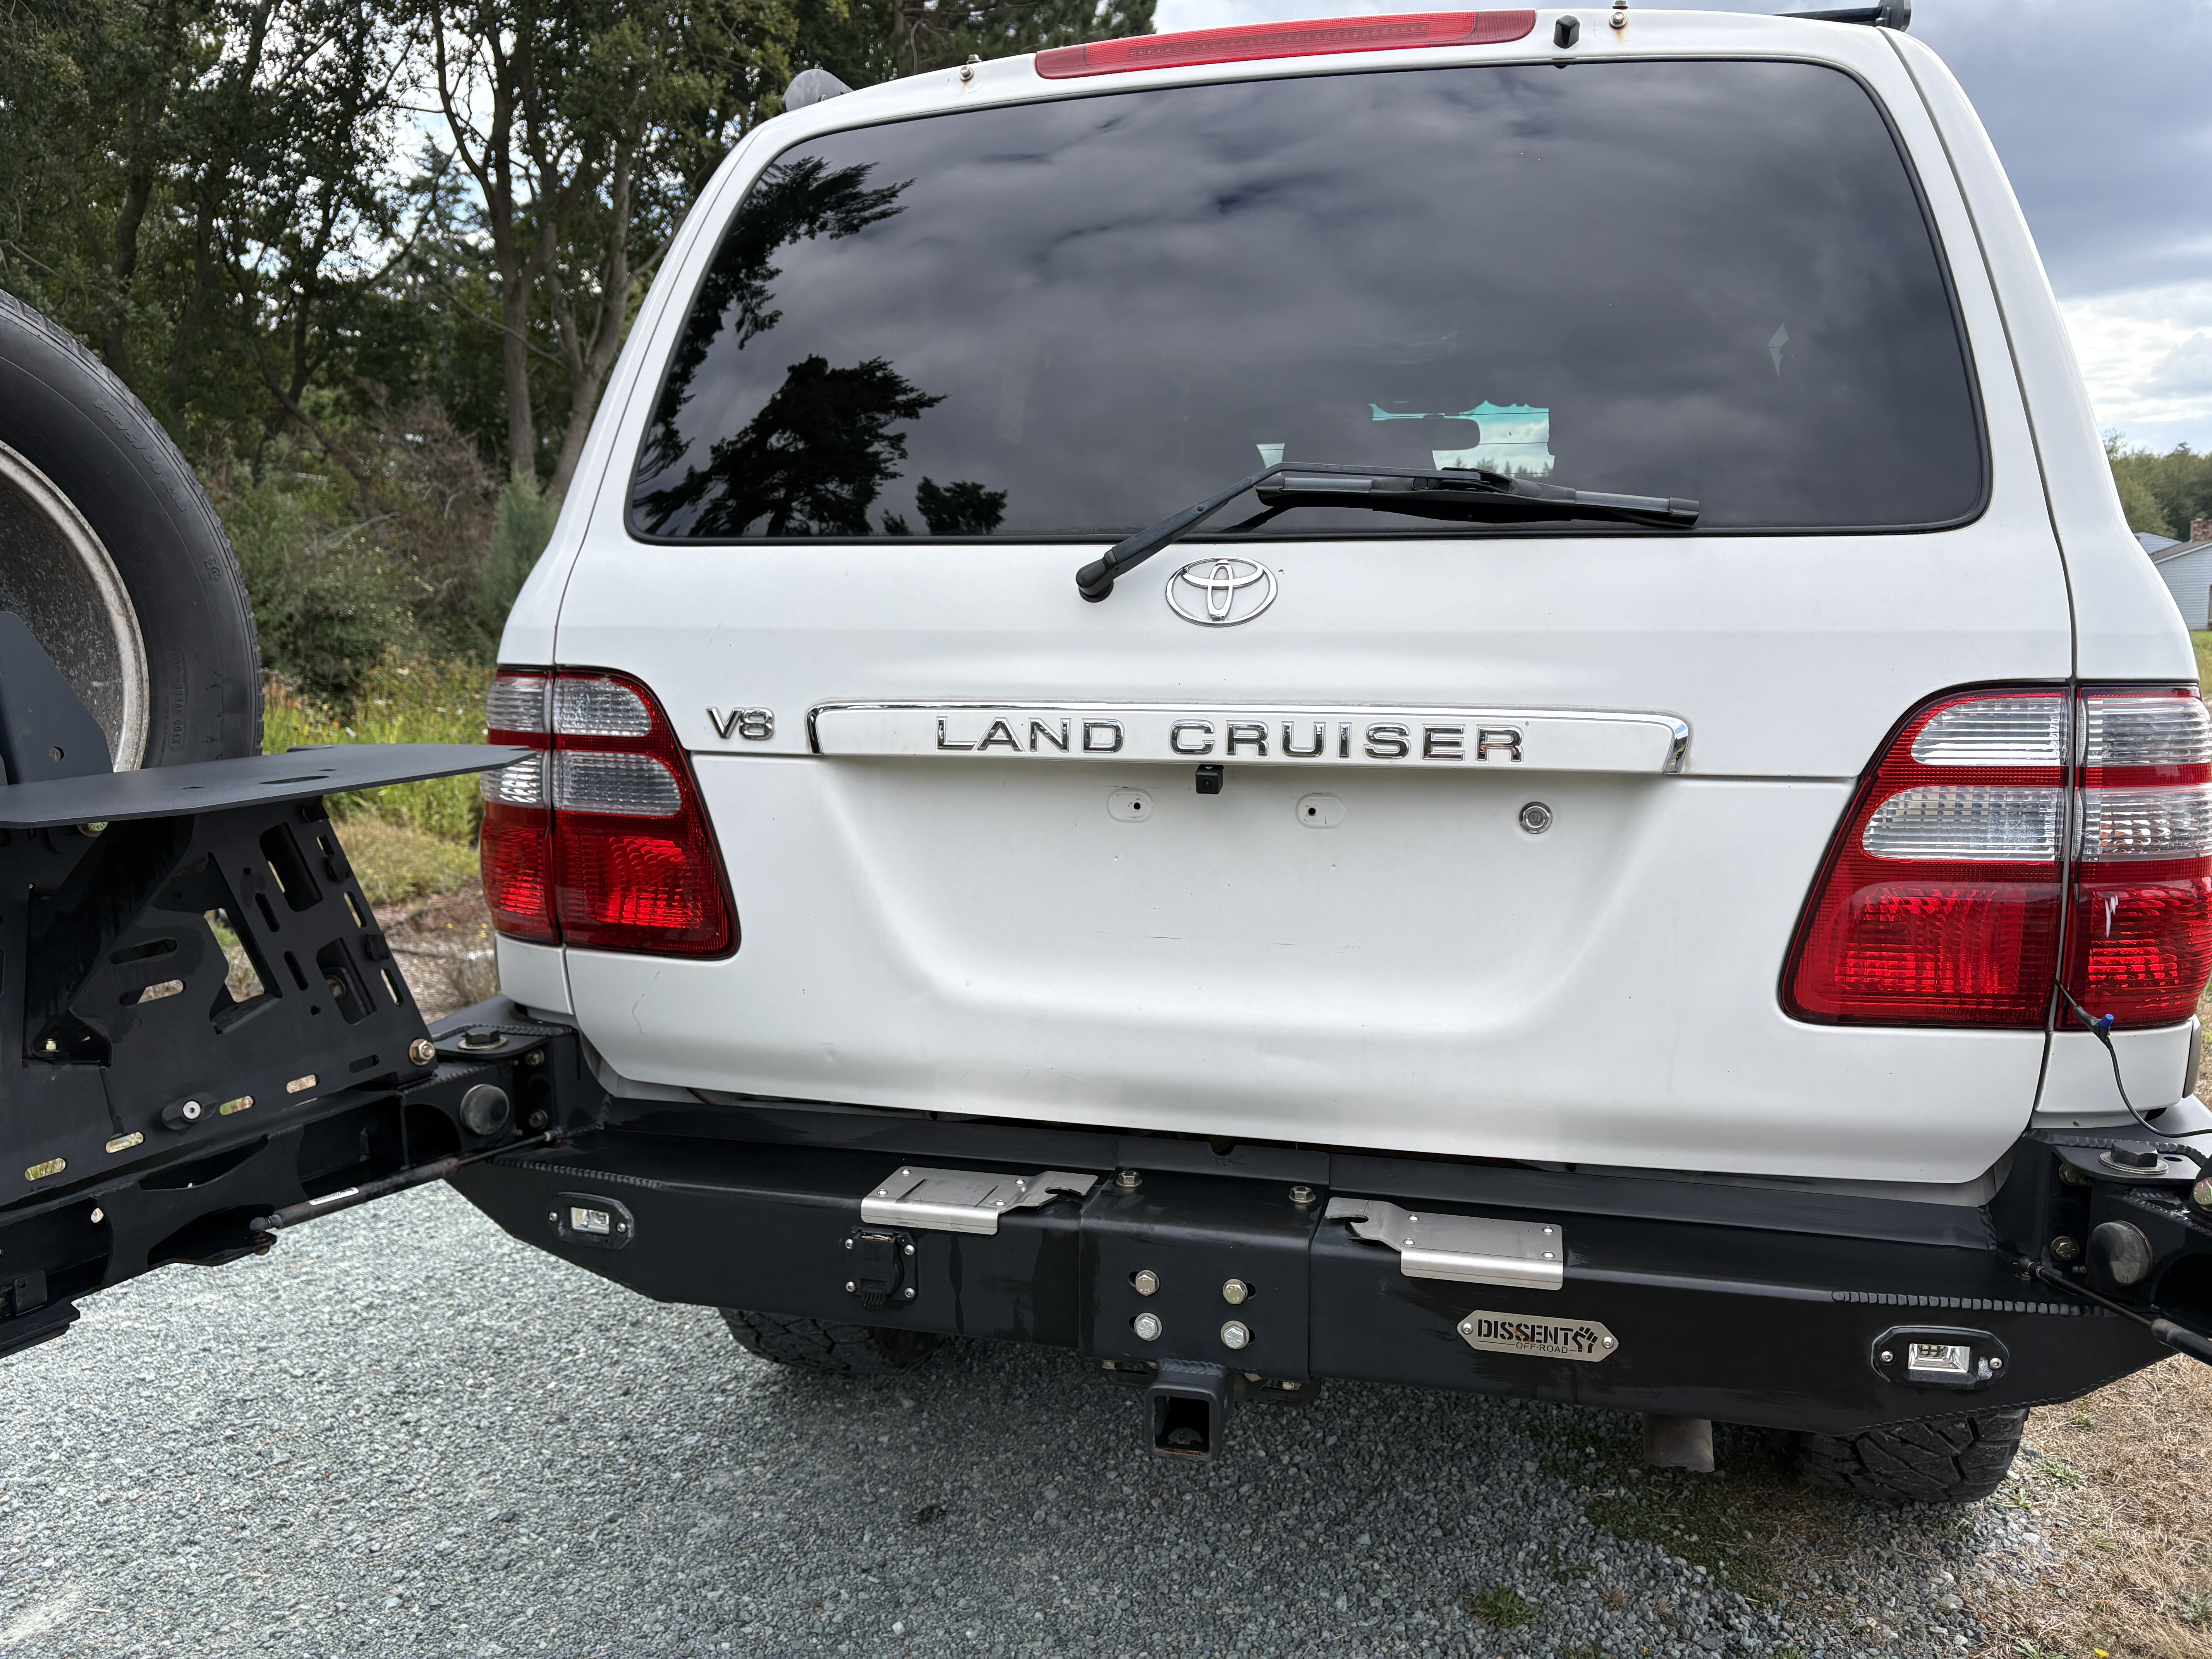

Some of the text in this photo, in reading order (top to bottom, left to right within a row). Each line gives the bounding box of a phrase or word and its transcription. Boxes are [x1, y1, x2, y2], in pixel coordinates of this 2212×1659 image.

[706, 706, 775, 740] V8
[936, 716, 1525, 763] LAND CRUISER
[1477, 1319, 1573, 1346] DISSENT
[1516, 1342, 1568, 1354] OFF-ROAD
